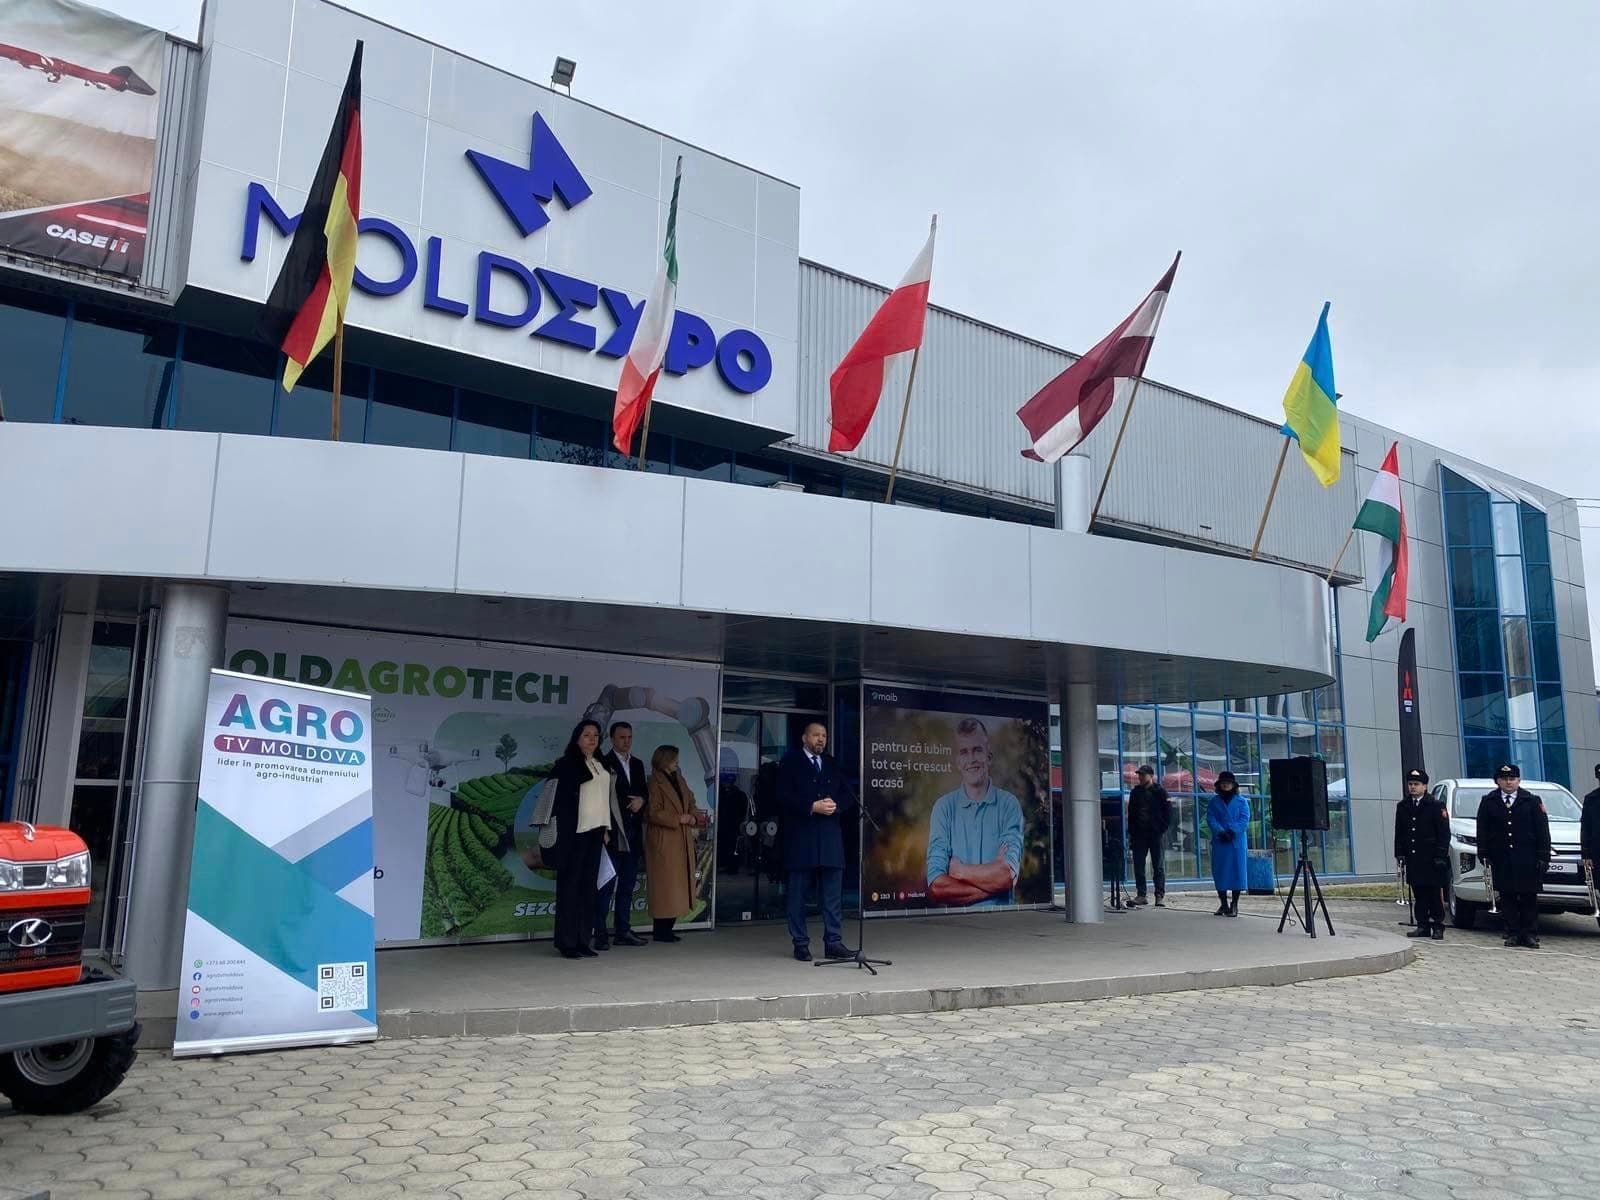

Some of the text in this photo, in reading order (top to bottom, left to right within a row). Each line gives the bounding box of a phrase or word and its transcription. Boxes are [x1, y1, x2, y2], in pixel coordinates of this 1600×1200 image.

[46, 224, 108, 249] CASE
[878, 692, 898, 702] maib
[218, 693, 364, 743] AGRO
[223, 736, 360, 764] TV MOLDOVA
[871, 741, 952, 755] pentru că iubim
[217, 758, 239, 767] lider
[254, 762, 308, 774] promovarea
[310, 768, 359, 779] domeniului
[871, 758, 952, 773] tot ce-i crescut
[256, 771, 323, 784] agro-industrial
[871, 776, 904, 788] acasă
